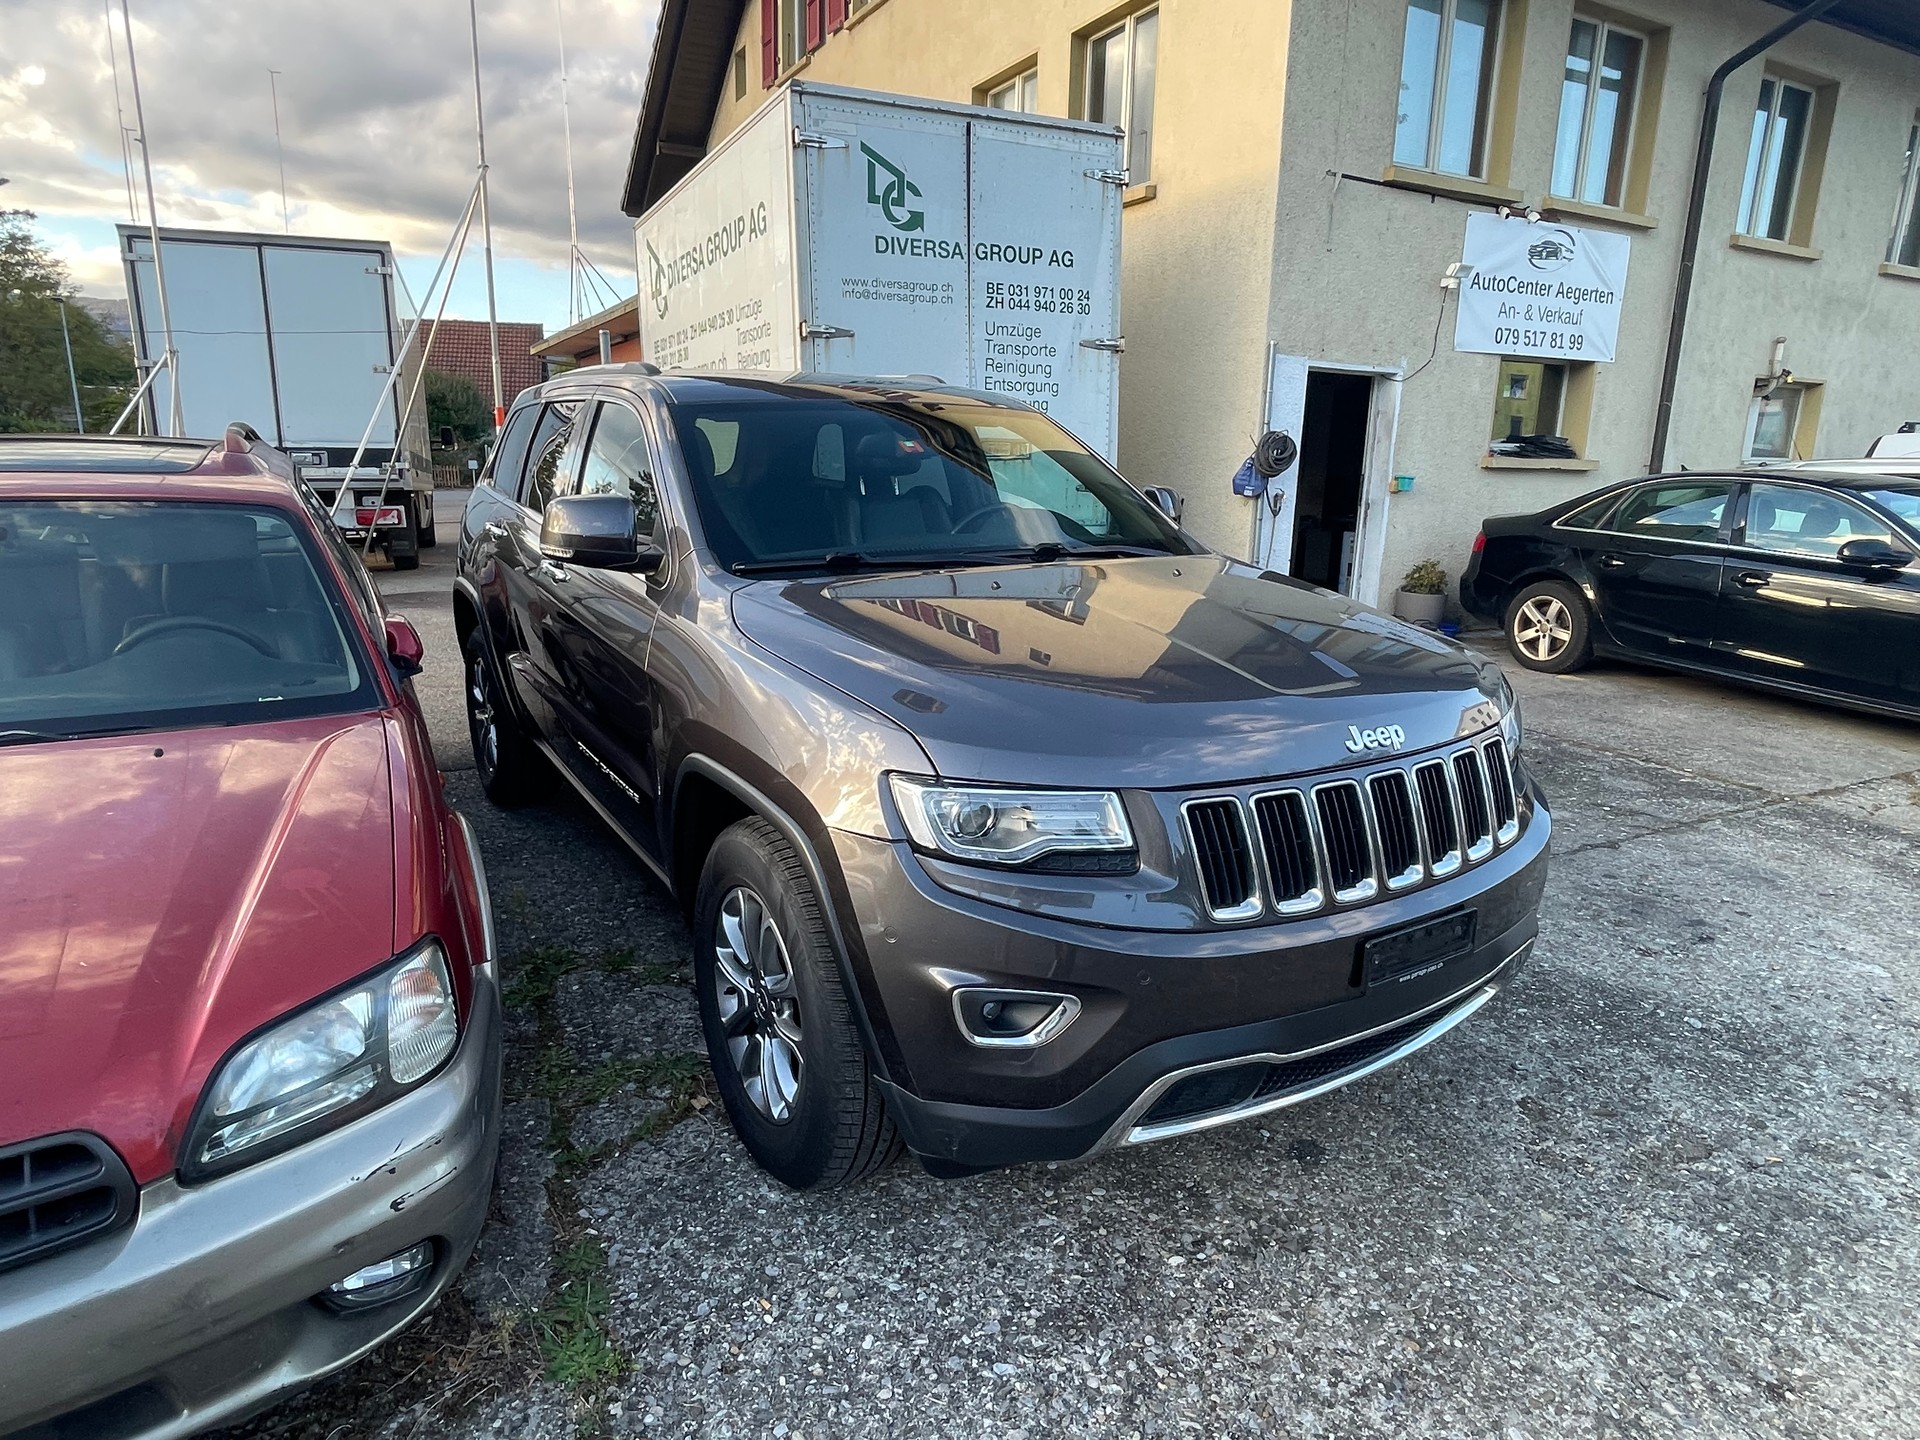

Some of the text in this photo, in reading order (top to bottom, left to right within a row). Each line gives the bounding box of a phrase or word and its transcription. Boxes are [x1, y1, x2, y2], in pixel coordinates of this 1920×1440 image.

[667, 201, 767, 290] DIVERSA GROUP AG
[875, 235, 1074, 268] DIVERSA GROUP AG
[841, 277, 954, 294] www.diversagroup.ch
[986, 282, 1090, 302] BE 031 971 00 24
[1470, 272, 1614, 305] AutoCenter Aegerten
[842, 289, 953, 305] info@diversagroup.ch
[986, 296, 1090, 315] ZH 044 940 26 30
[735, 298, 763, 322] Umzüge
[1498, 302, 1583, 325] An- & Verkauf
[690, 323, 697, 340] ZH
[708, 315, 718, 333] 940
[718, 311, 725, 329] 26
[726, 308, 734, 326] 30
[736, 319, 772, 347] Transporte
[985, 321, 1041, 341] Umzüge
[984, 339, 1056, 358] Transporte
[1495, 327, 1583, 351] 079 517 81 99
[737, 348, 770, 369] Reinigung
[985, 358, 1052, 378] Reinigung
[985, 376, 1059, 397] Entsorgung
[1345, 724, 1406, 752] Jeep
